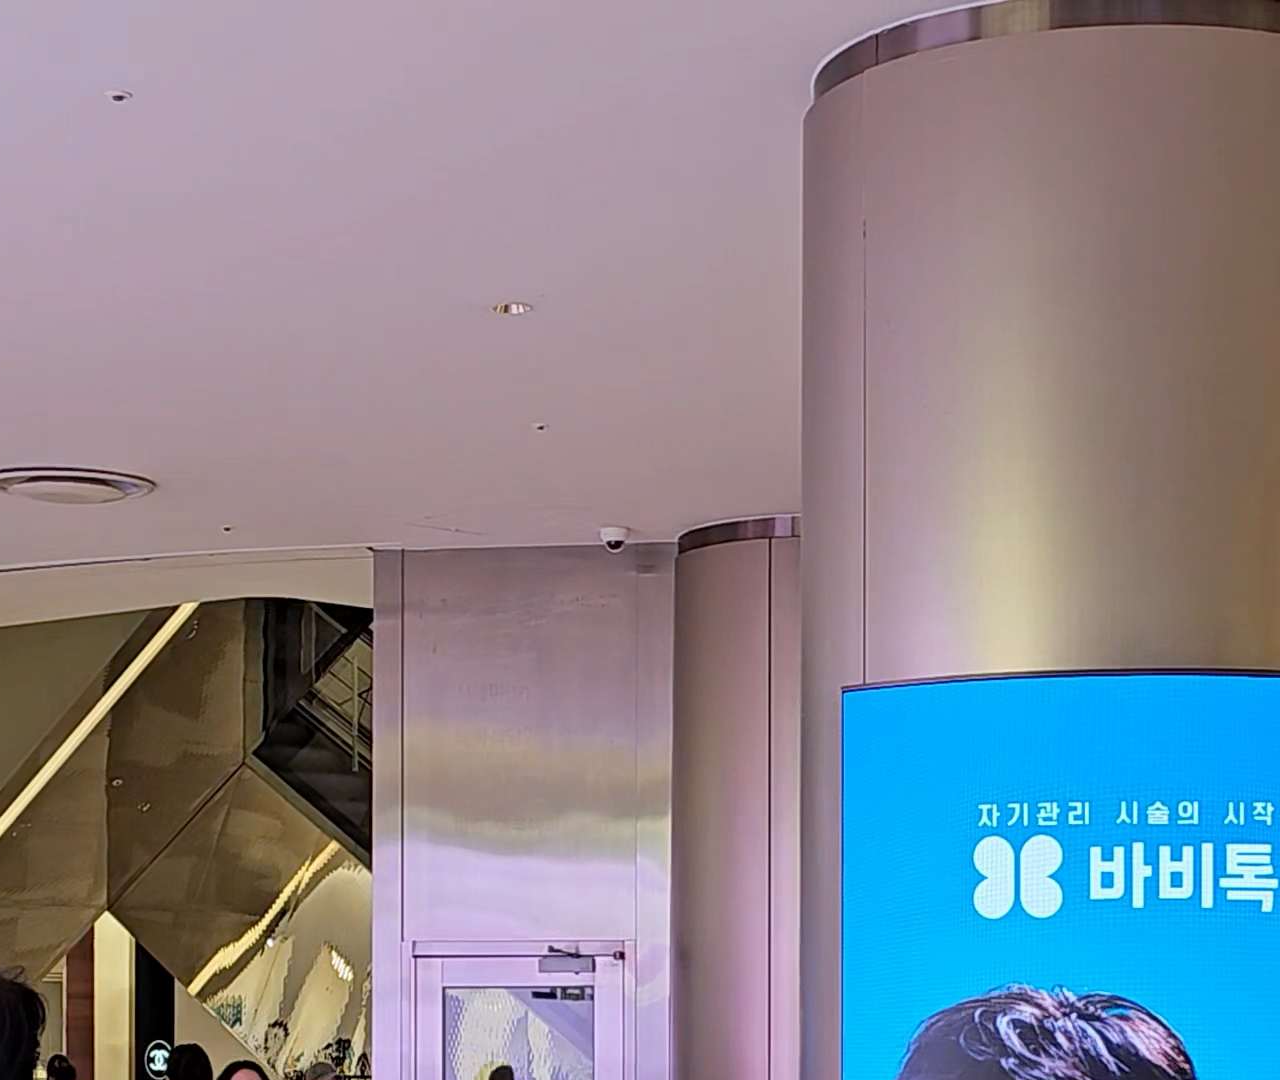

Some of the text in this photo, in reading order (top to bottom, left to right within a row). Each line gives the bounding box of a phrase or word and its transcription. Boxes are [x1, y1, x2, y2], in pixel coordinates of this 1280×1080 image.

[978, 801, 1275, 828] 자기관리 시술의 시작
[1088, 842, 1280, 914] 바비톡
